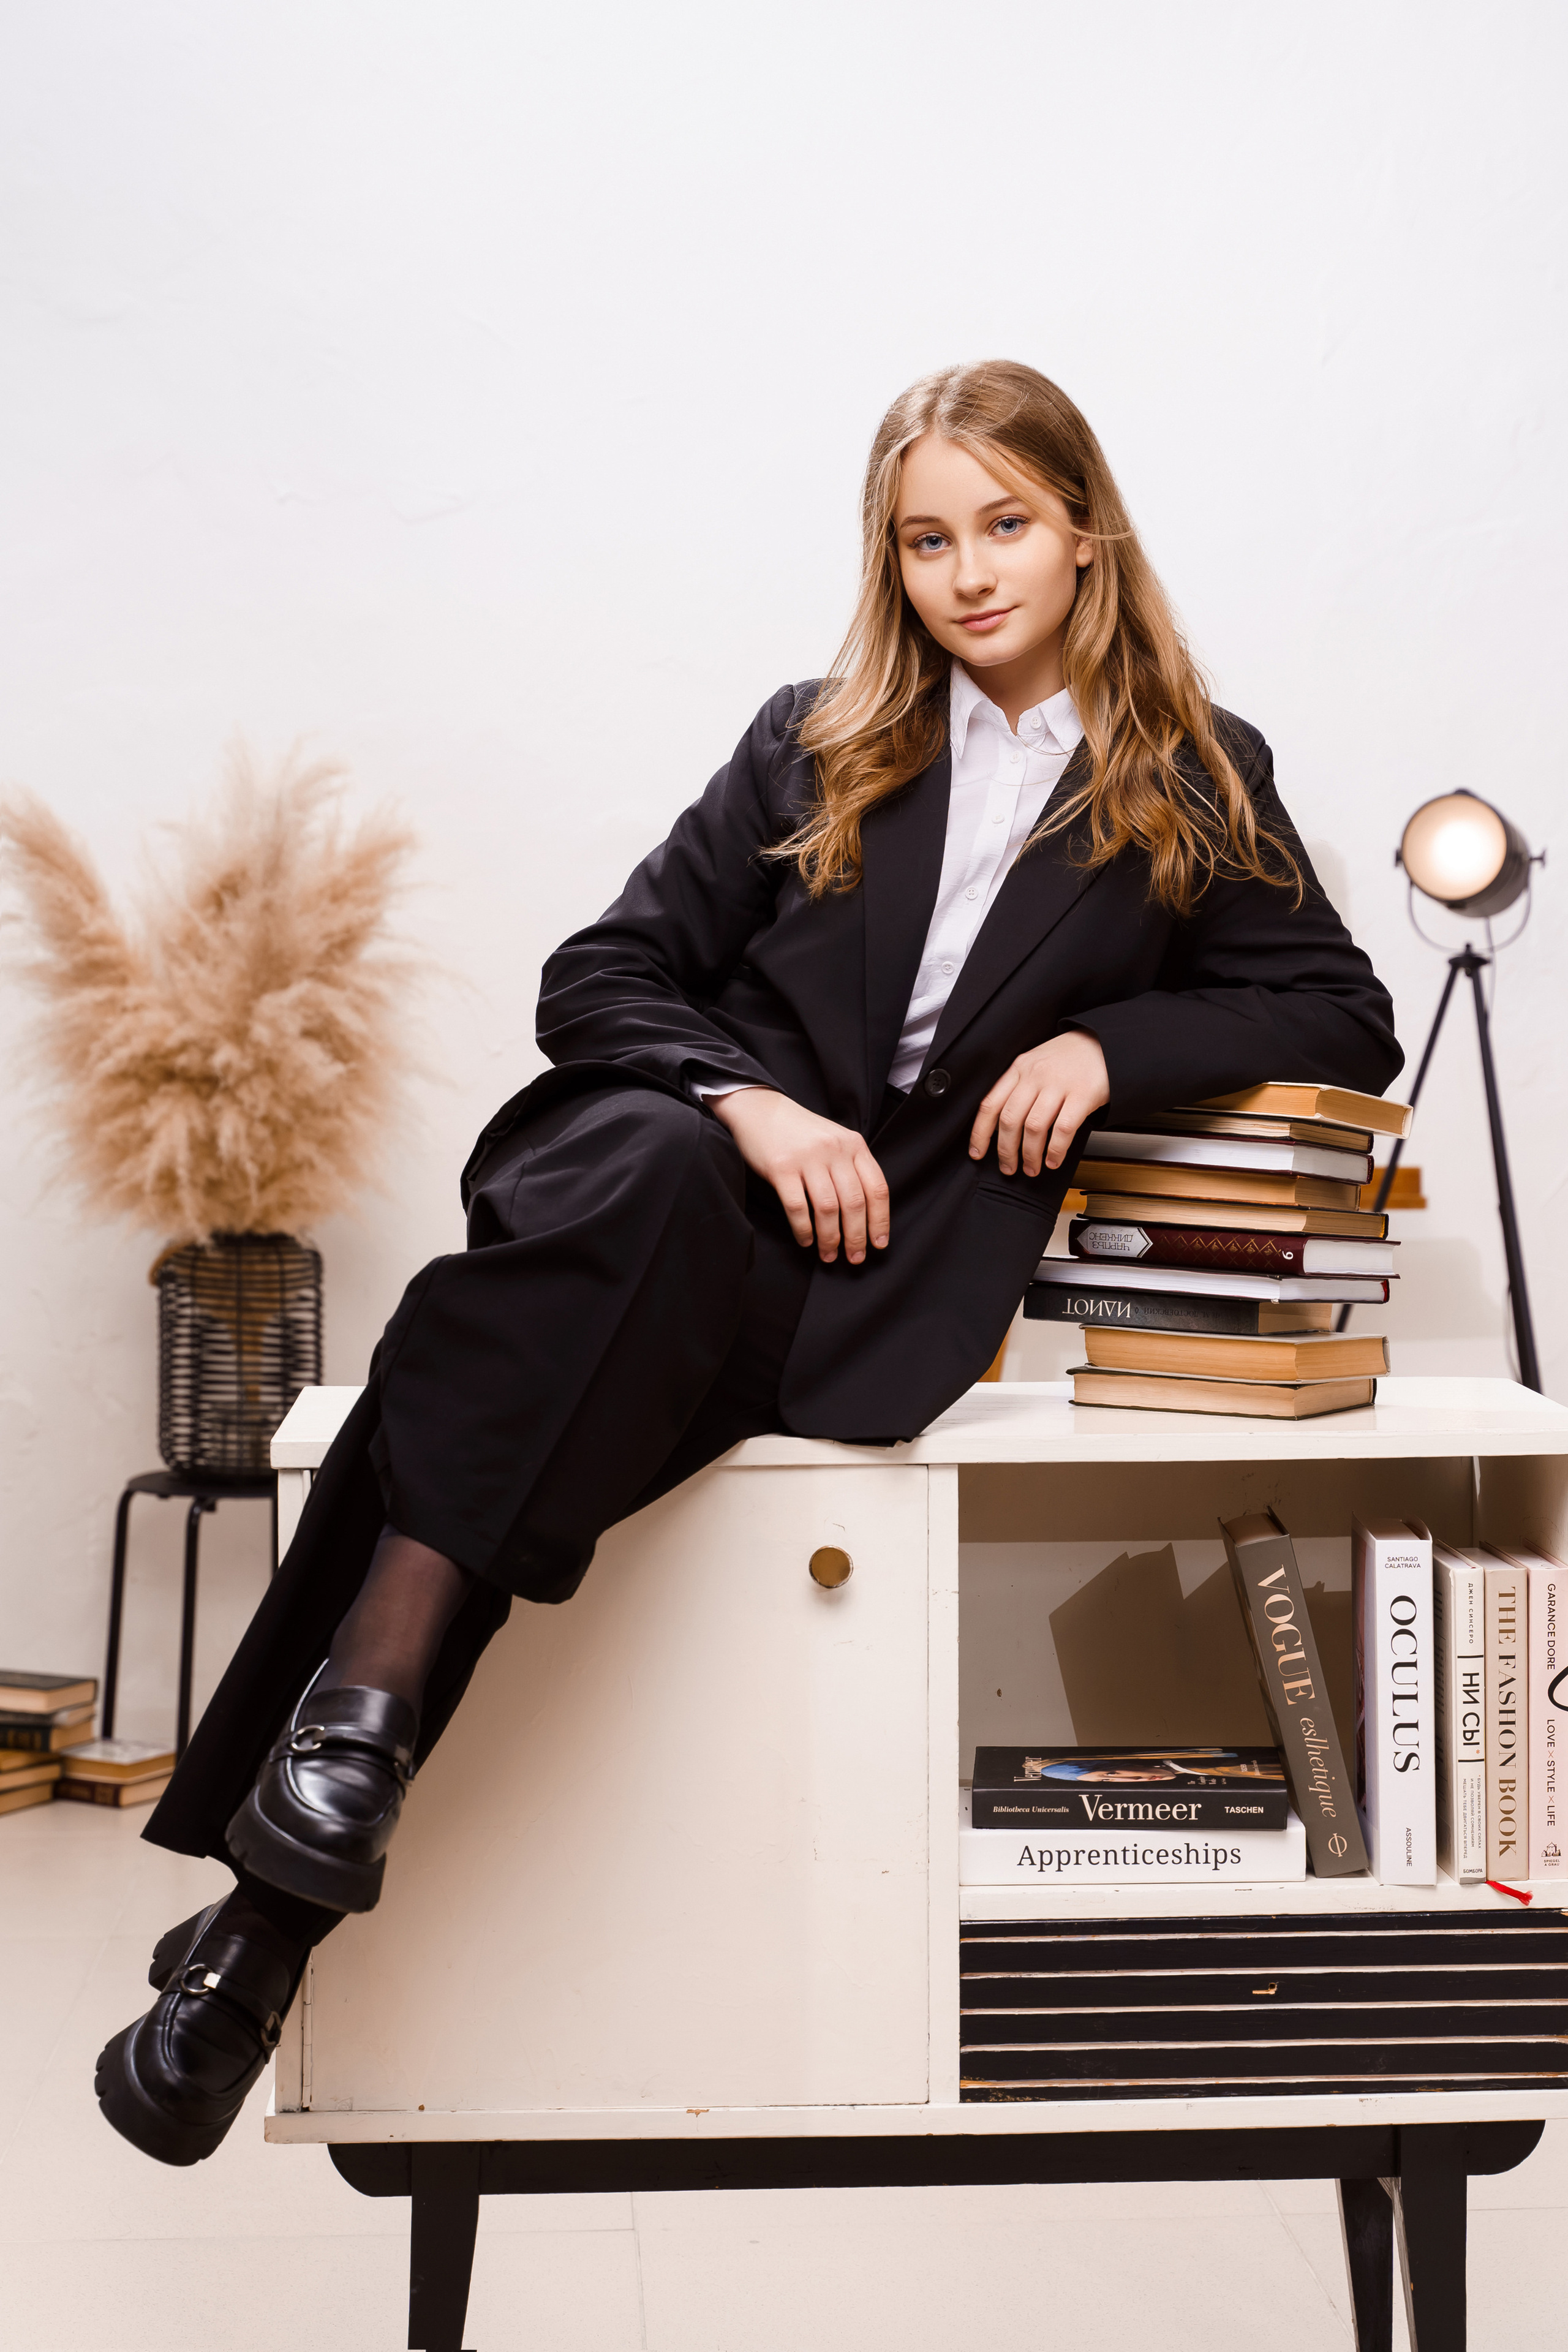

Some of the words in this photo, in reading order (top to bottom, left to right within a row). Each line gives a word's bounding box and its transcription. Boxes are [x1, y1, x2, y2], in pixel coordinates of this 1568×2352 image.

[1089, 1232, 1134, 1243] ДИККЕНС
[1092, 1241, 1131, 1251] ЧАРЛЬЗ
[1062, 1298, 1131, 1318] ИДИОТ
[1144, 1306, 1199, 1317] ДОСТОЕВСКИЙ
[1498, 1586, 1517, 1645] THE
[1547, 1583, 1556, 1637] GARANCE
[1257, 1564, 1316, 1705] VOGUE
[1547, 1640, 1556, 1670] DORE
[1390, 1595, 1420, 1773] OCULUS
[1462, 1672, 1480, 1705] НИ
[1547, 1719, 1556, 1748] LOVE
[1547, 1760, 1556, 1793] STYLE
[1079, 1794, 1202, 1821] Vermeer
[1498, 1777, 1518, 1858] BOOK
[1547, 1805, 1556, 1826] LIFE
[1016, 1842, 1242, 1872] Apprenticeships
